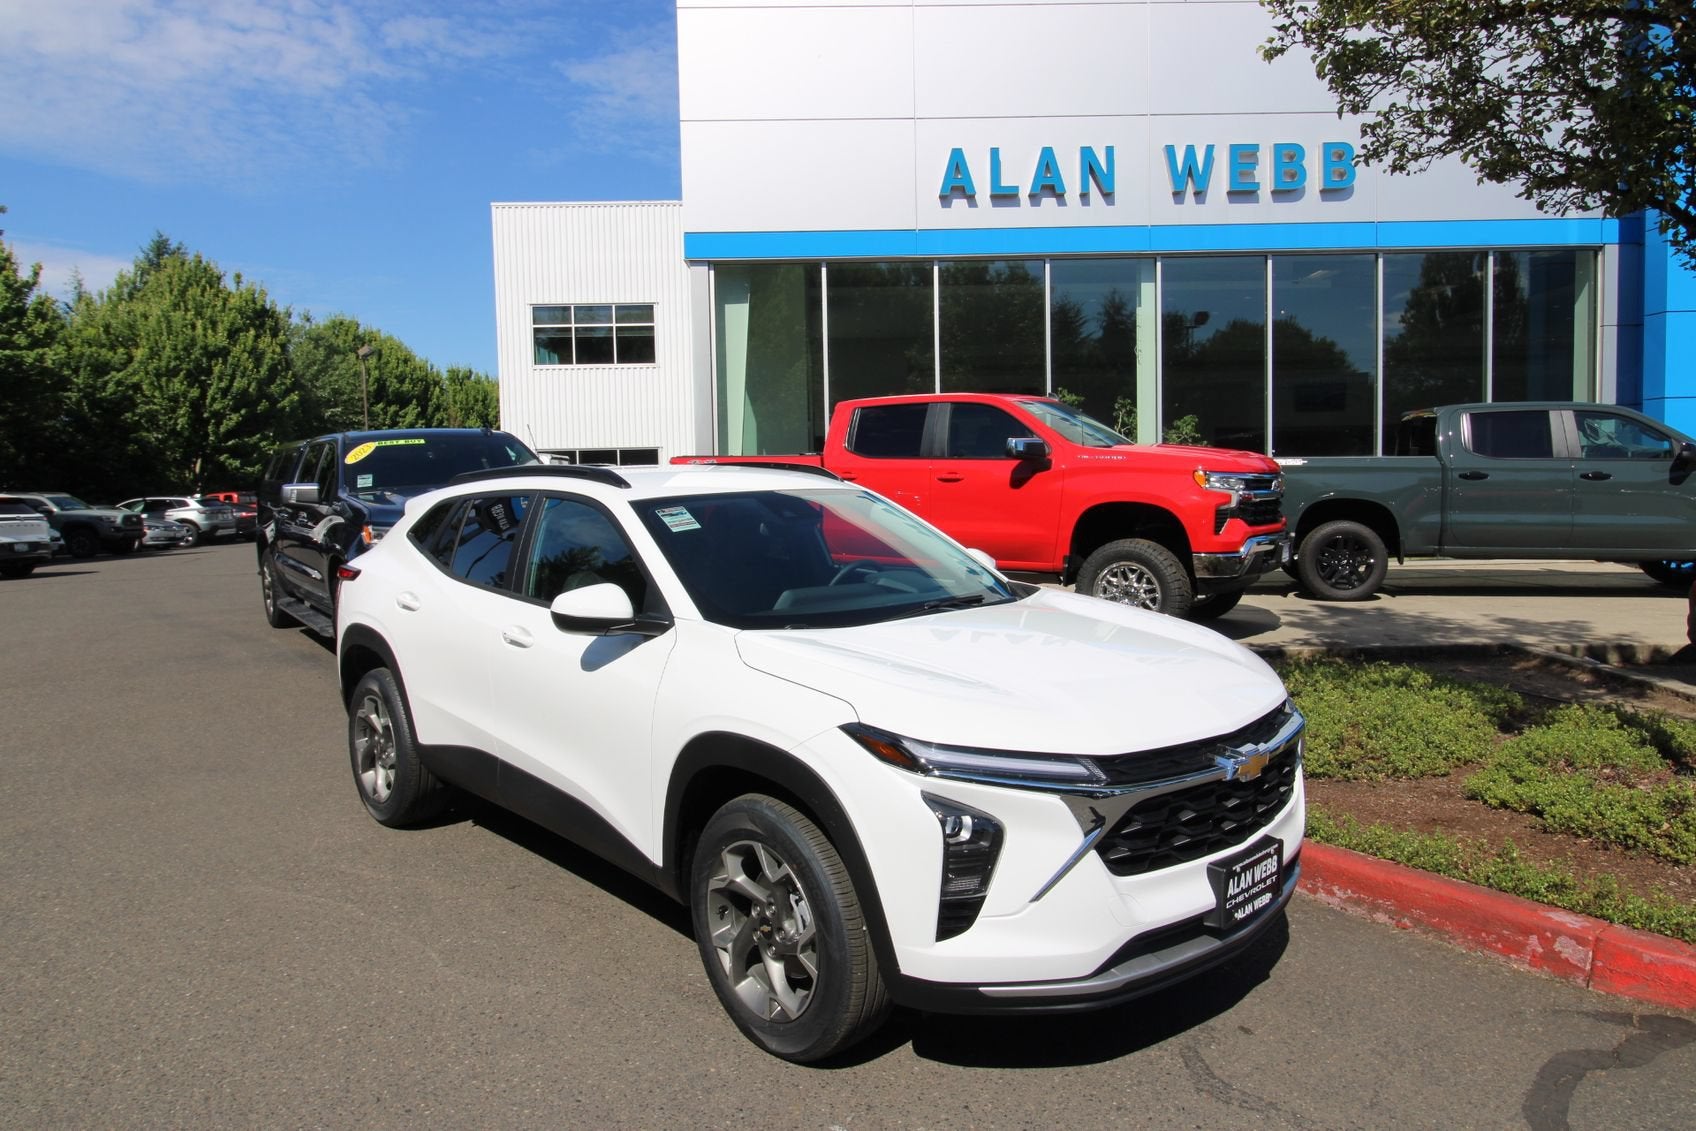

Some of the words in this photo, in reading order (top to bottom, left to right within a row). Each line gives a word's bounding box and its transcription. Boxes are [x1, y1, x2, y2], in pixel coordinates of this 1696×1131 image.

[938, 145, 1115, 198] ALAN
[1164, 141, 1357, 196] WEBB
[1226, 875, 1278, 909] CHEVROLET
[1227, 868, 1253, 898] ALAN
[1254, 855, 1278, 883] WEBB
[1237, 902, 1253, 920] ALAN
